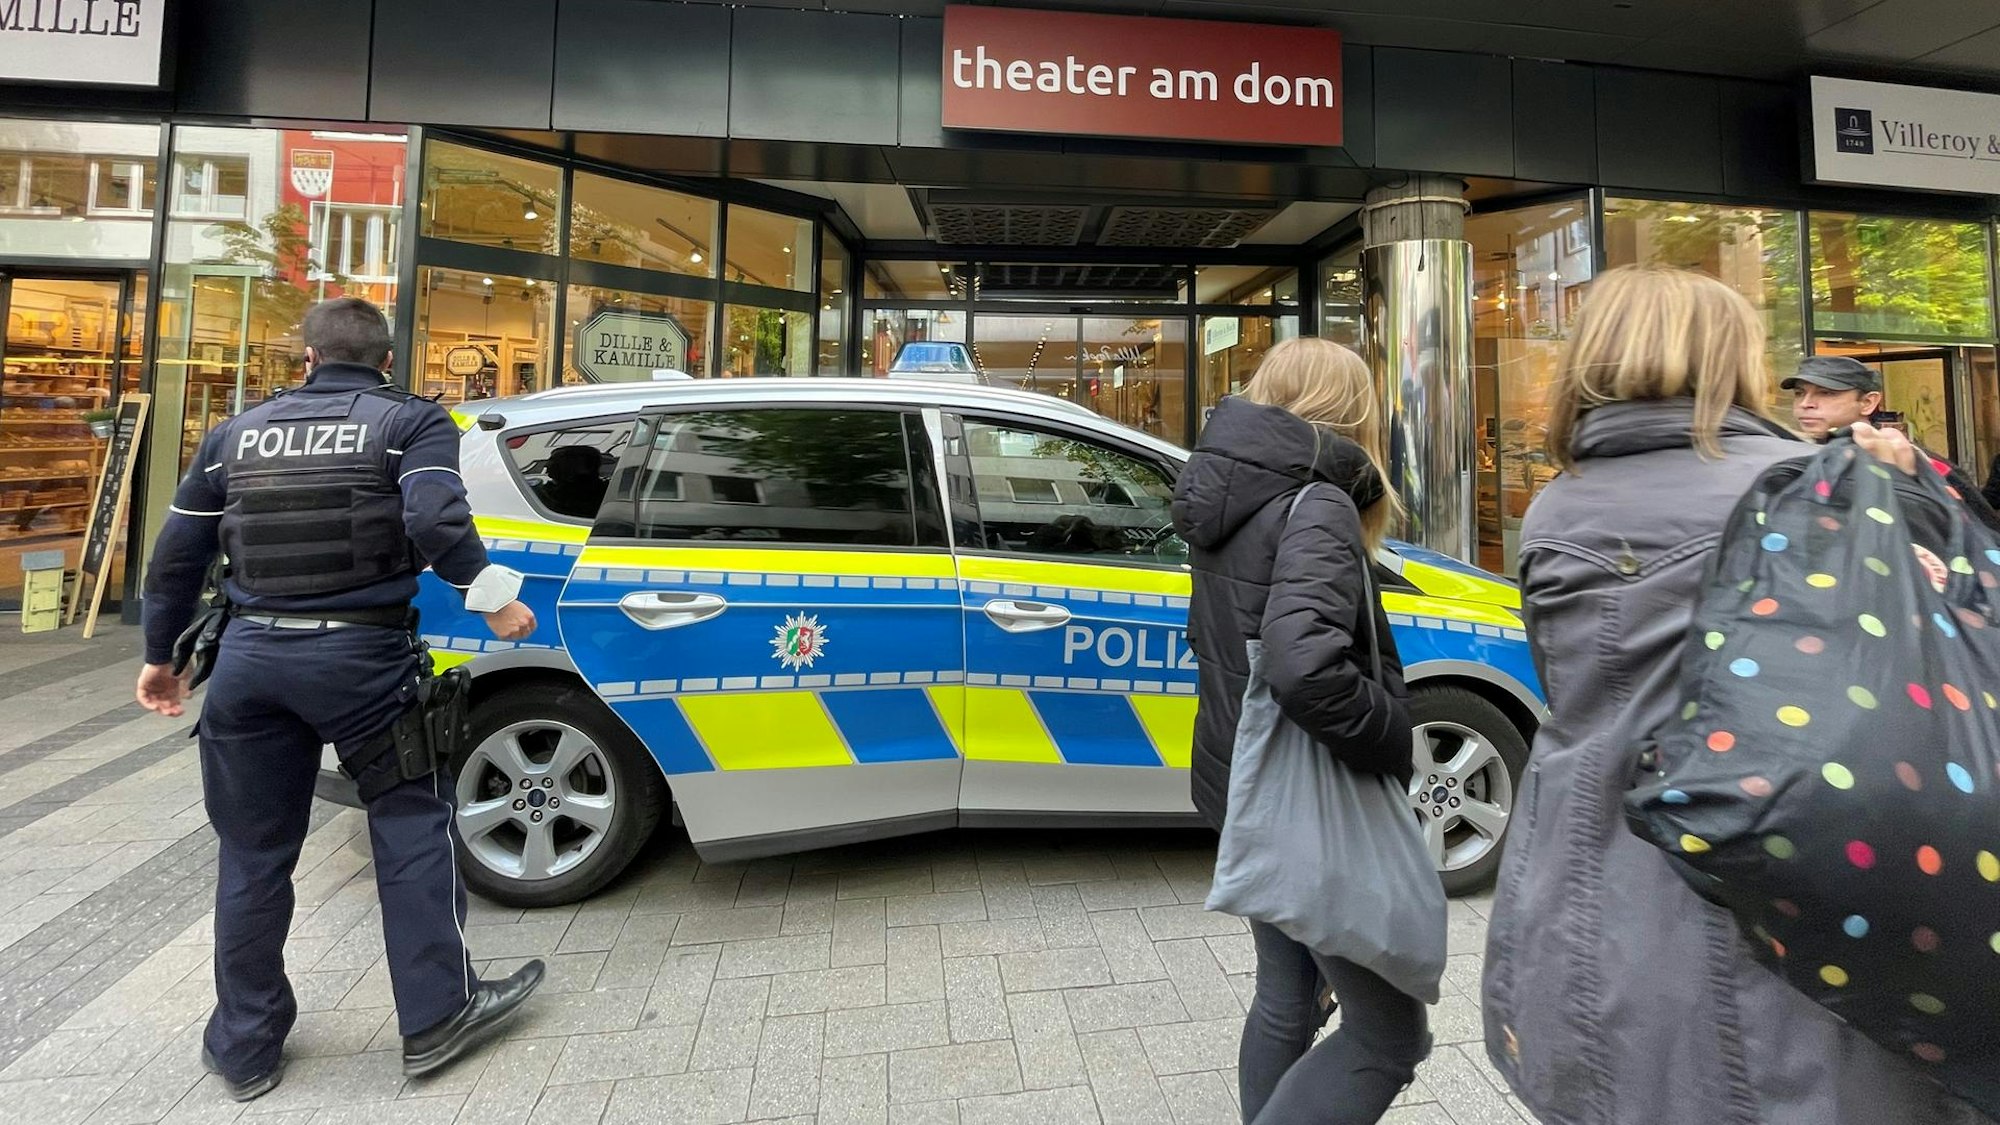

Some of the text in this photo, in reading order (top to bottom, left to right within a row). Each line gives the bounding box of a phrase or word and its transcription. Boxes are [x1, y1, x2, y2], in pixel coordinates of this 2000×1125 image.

[953, 45, 1334, 108] theater am dom
[1879, 120, 2000, 159] Villeroy &
[593, 349, 676, 369] KAMILLE
[600, 333, 672, 353] DILLE &
[236, 424, 368, 460] POLIZEI
